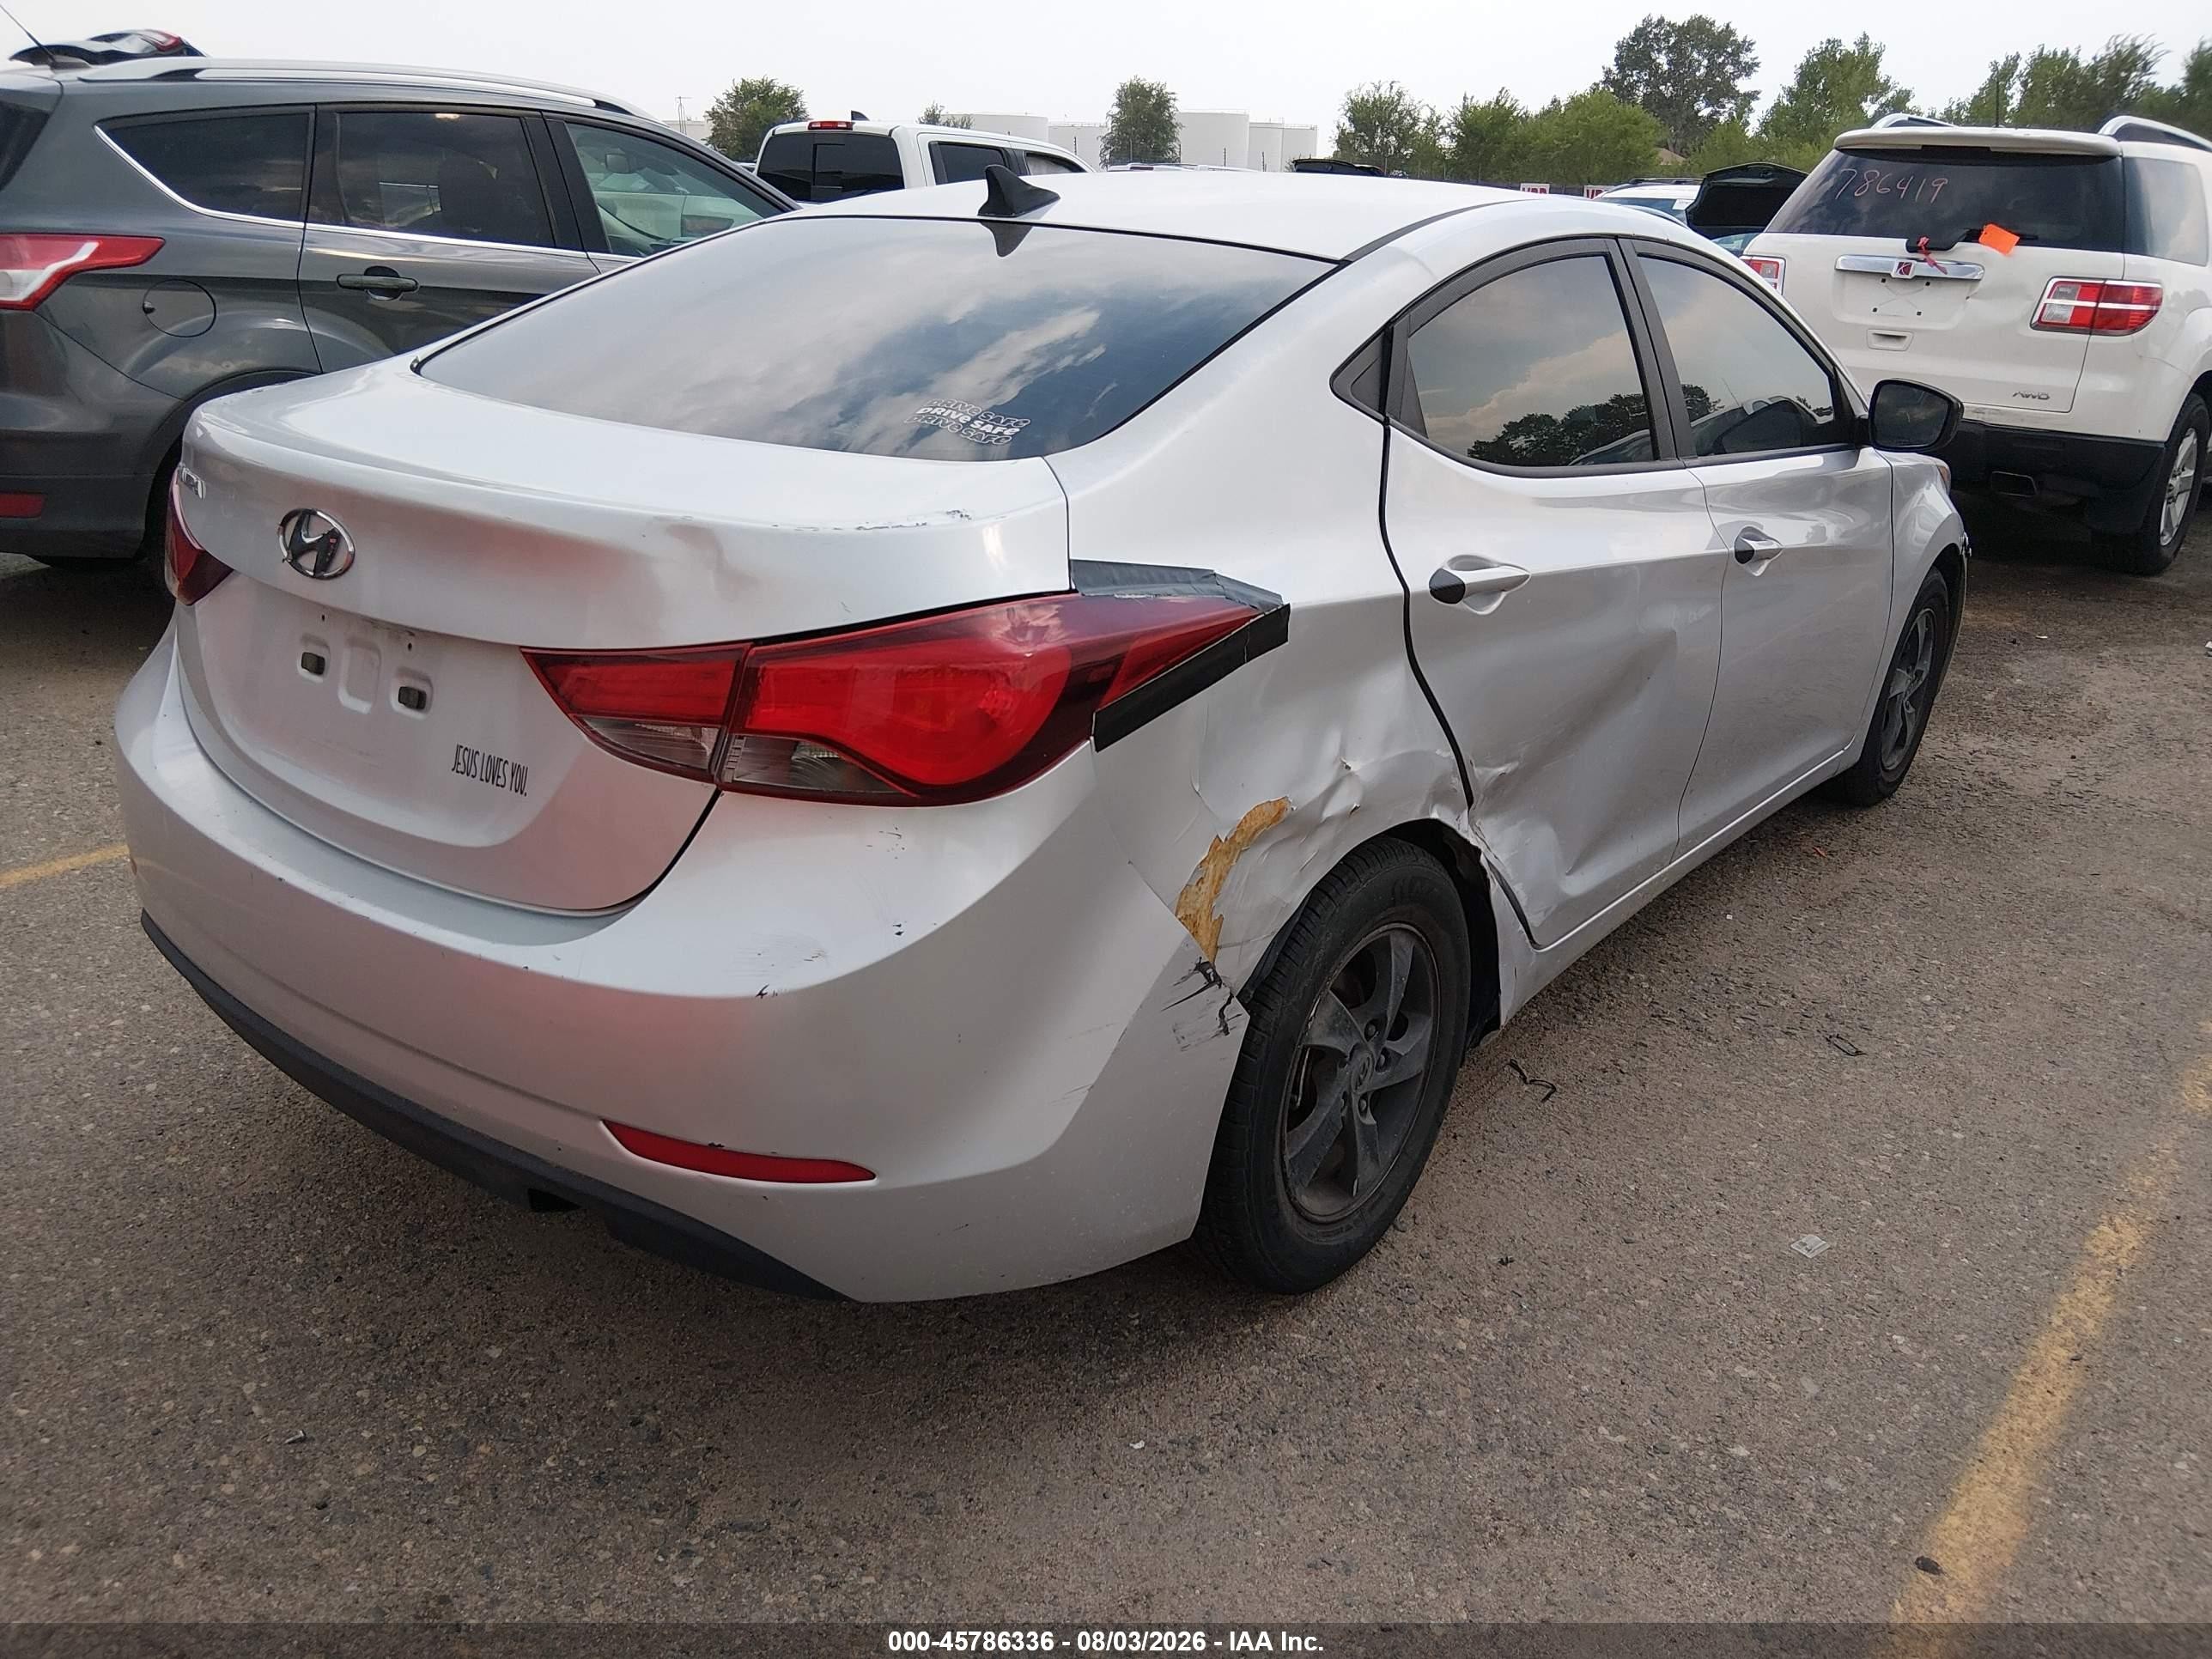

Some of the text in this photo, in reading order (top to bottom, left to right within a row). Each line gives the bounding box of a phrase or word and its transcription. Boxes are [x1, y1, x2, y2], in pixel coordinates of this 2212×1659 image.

[1835, 168, 1948, 204] 786419
[2012, 391, 2051, 400] AWD
[451, 743, 528, 797] JESUS LOVES YOU.
